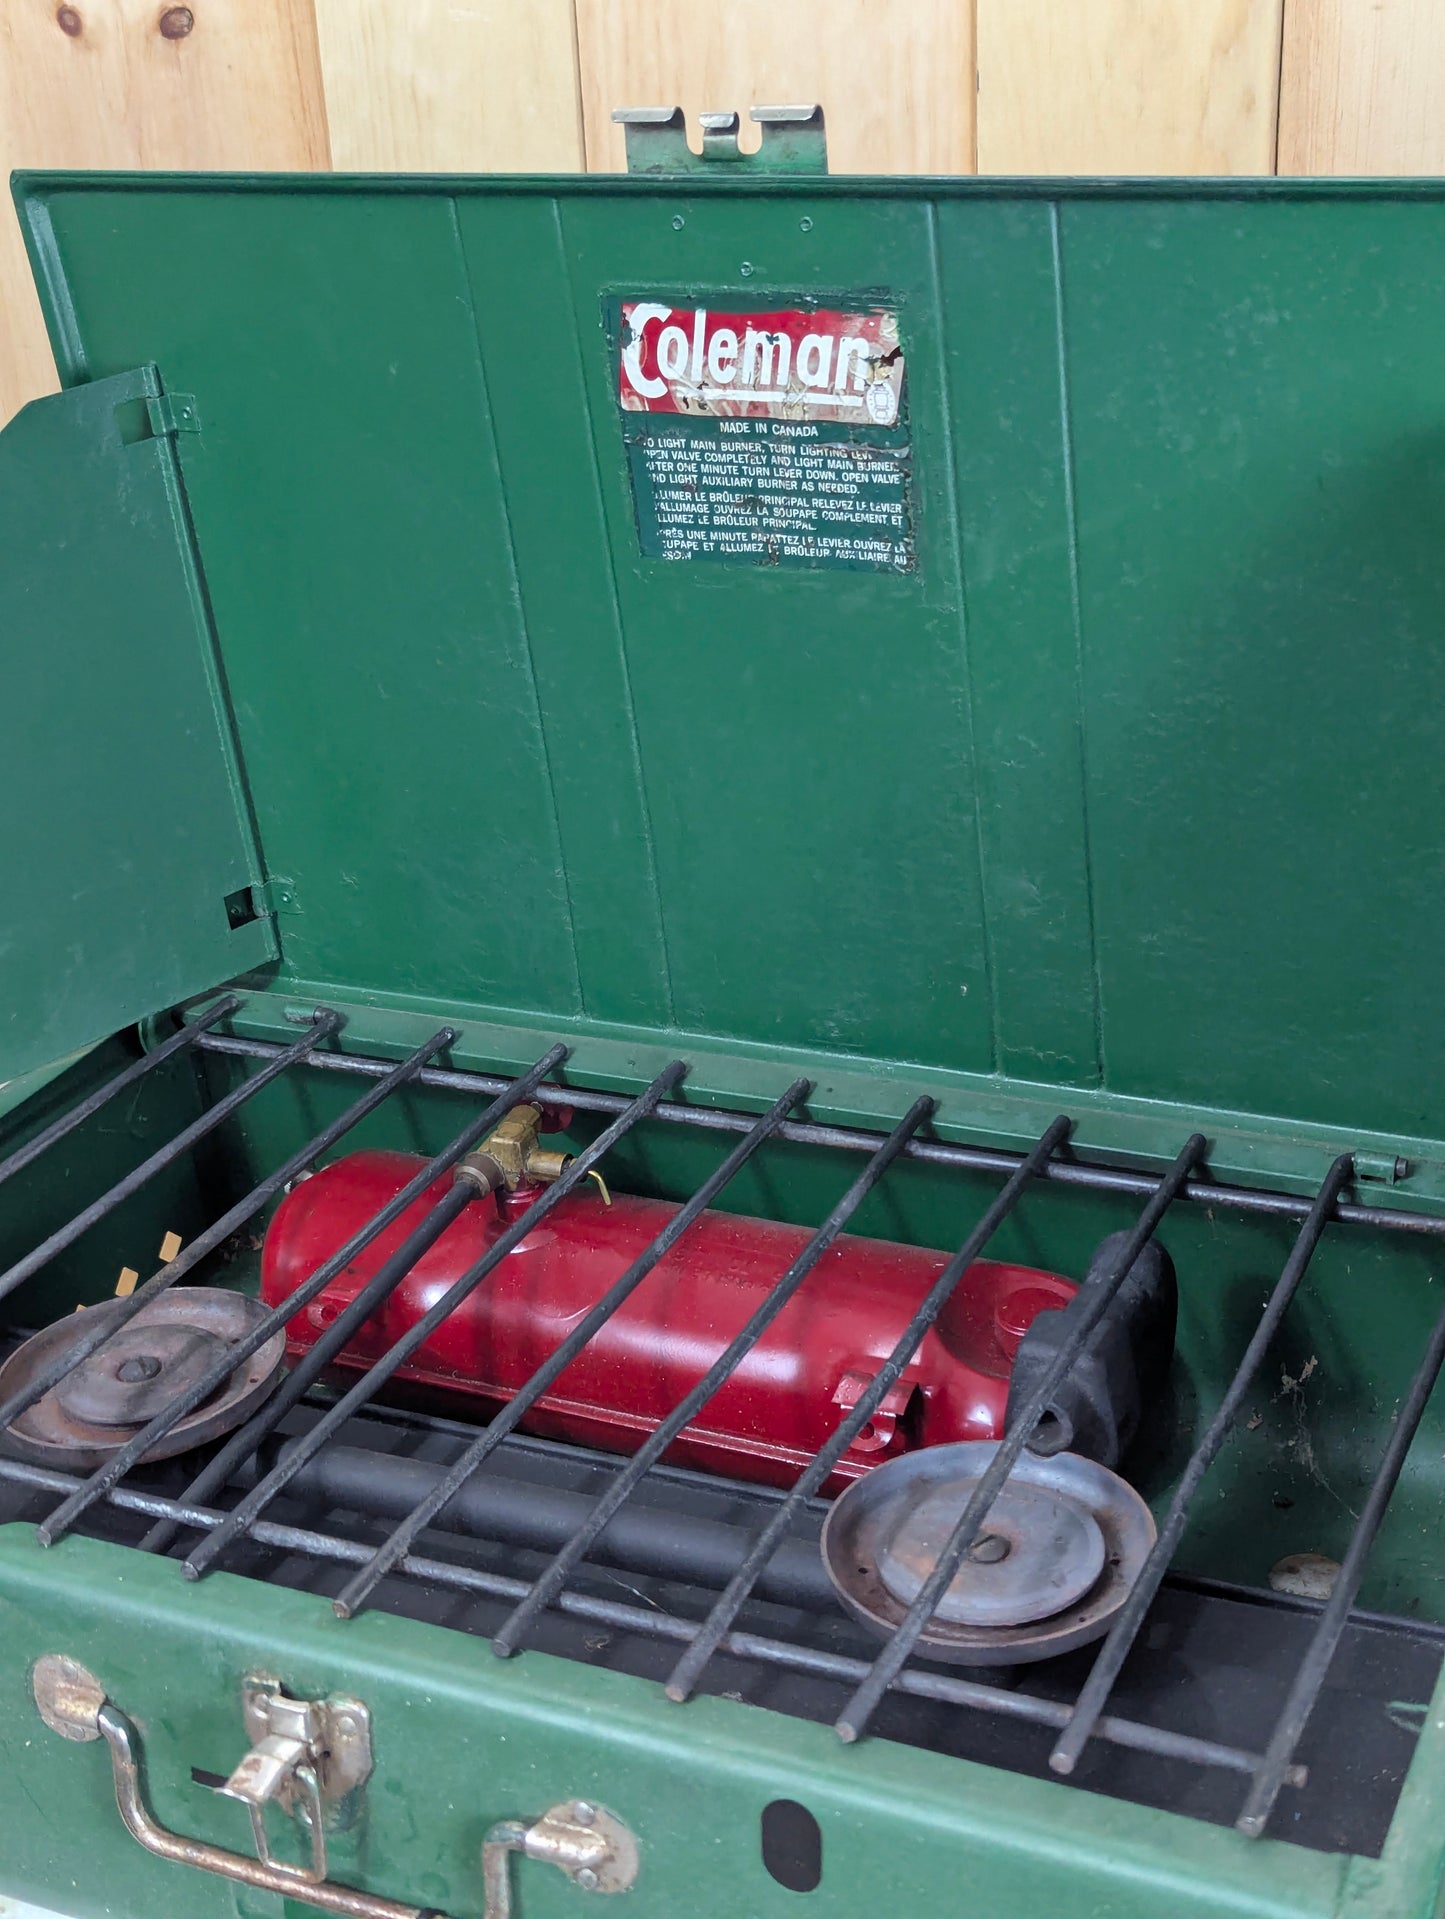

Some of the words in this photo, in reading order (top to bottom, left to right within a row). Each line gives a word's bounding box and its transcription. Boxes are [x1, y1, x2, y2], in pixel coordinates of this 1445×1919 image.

[622, 303, 870, 399] Coleman
[720, 422, 751, 434] MADE
[755, 423, 767, 434] IN
[772, 424, 819, 437] CANADA
[643, 438, 654, 448] O
[658, 438, 686, 449] LIGHT
[690, 440, 716, 451] MAIN
[721, 442, 765, 454] BURNER,
[769, 443, 796, 455] TURN
[800, 444, 847, 458] LIGHTING
[851, 449, 873, 461] LEV
[671, 451, 702, 462] VALVE
[704, 452, 767, 465] COMPLETELY
[771, 455, 791, 467] AND
[794, 457, 823, 468] LIGHT
[827, 459, 854, 471] MAIN
[648, 473, 666, 484] ND
[669, 473, 698, 485] LIGHT
[702, 476, 753, 488] AUXILIARY
[757, 478, 798, 490] BURNER
[801, 481, 815, 492] AS
[818, 482, 860, 494] NEEDED.
[677, 462, 698, 473] ONE
[701, 463, 740, 475] MINUTE
[742, 466, 770, 477] TURN
[773, 467, 803, 479] LEVER
[806, 469, 838, 481] DOWN.
[842, 472, 869, 483] OPEN
[871, 473, 900, 484] VALVE
[695, 491, 707, 502] LE
[812, 498, 854, 510] RELEVEZ
[870, 501, 902, 513] LEVIER
[657, 513, 694, 524] LLUMEZ
[698, 514, 710, 525] LE
[713, 514, 759, 526] BRÛLEUR
[714, 503, 752, 515] OUVREZ
[756, 506, 769, 516] LA
[773, 507, 818, 519] SOUPAPE
[891, 514, 903, 526] ET
[686, 530, 707, 540] UNE
[710, 531, 748, 542] MINUTE
[817, 537, 851, 548] LEVIER
[853, 540, 892, 552] OUVREZ
[894, 542, 906, 554] LA
[703, 542, 715, 552] ET
[720, 543, 764, 553] ALLUMEZ
[784, 545, 832, 557] BRÛLEUR
[836, 549, 890, 563] AUXLIAIRE
[894, 555, 907, 565] AU
